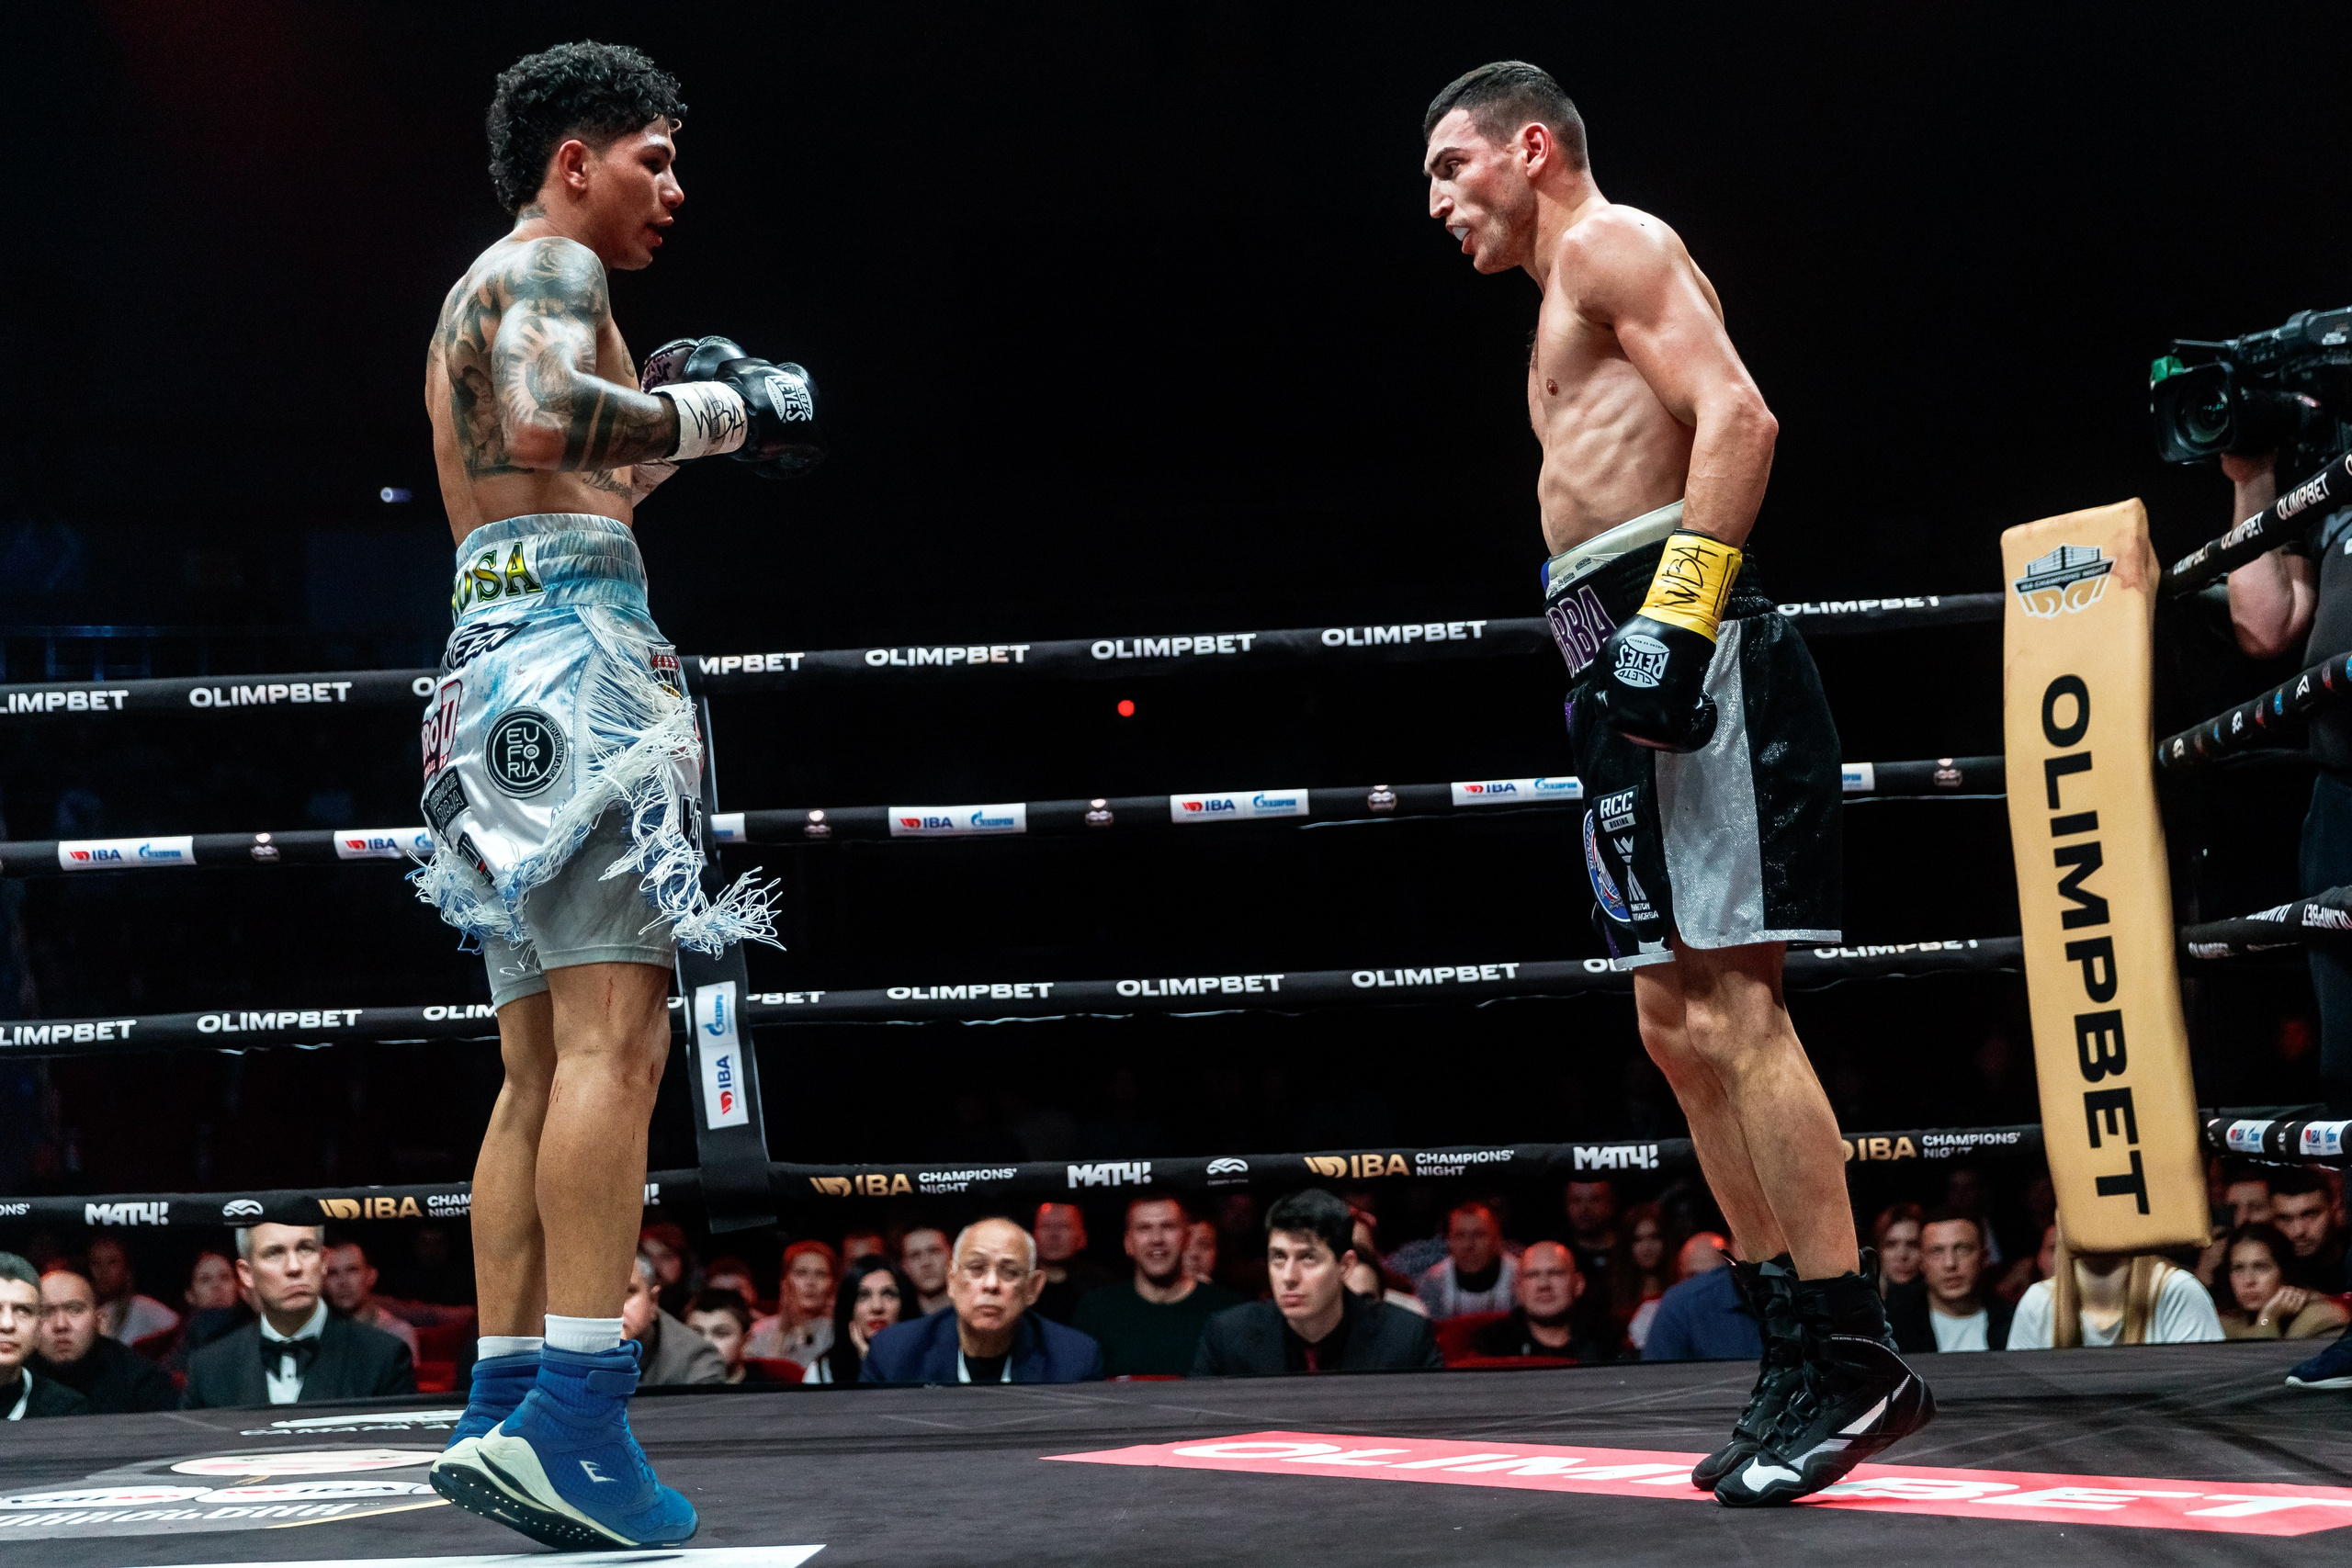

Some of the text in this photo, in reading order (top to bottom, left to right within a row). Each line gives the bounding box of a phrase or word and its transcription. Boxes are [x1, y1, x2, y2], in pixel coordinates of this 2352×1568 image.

[772, 375, 807, 422] REYES
[2278, 471, 2330, 520] OLIMPBET
[1777, 595, 1940, 616] OLIMPBET
[1321, 620, 1487, 646] OLIMPBET
[865, 644, 1031, 667] OLIMPBET
[1091, 632, 1256, 660] OLIMPBET
[1614, 644, 1669, 680] REYES
[1617, 669, 1653, 685] CLETO
[189, 682, 352, 707] OLIMPBET
[543, 719, 565, 780] INDUMENTARIA
[1204, 798, 1236, 812] IBA
[1600, 791, 1634, 818] RCC
[922, 817, 953, 829] IBA
[92, 849, 122, 862] IBA
[368, 838, 398, 851] IBA
[2041, 673, 2151, 1216] OLIMPBET
[1116, 974, 1285, 998] OLIMPBET
[1351, 963, 1521, 988] OLIMPBET
[887, 983, 1055, 1000] OLIMPBET
[196, 1009, 363, 1034] OLIMPBET
[719, 1055, 732, 1089] IBA
[1858, 1136, 1917, 1161] IBA
[1351, 1154, 1410, 1179] IBA
[1416, 1165, 1465, 1177] NIGHT
[856, 1174, 912, 1196] IBA
[919, 1182, 969, 1194] NIGHT
[366, 1197, 423, 1219] IBA
